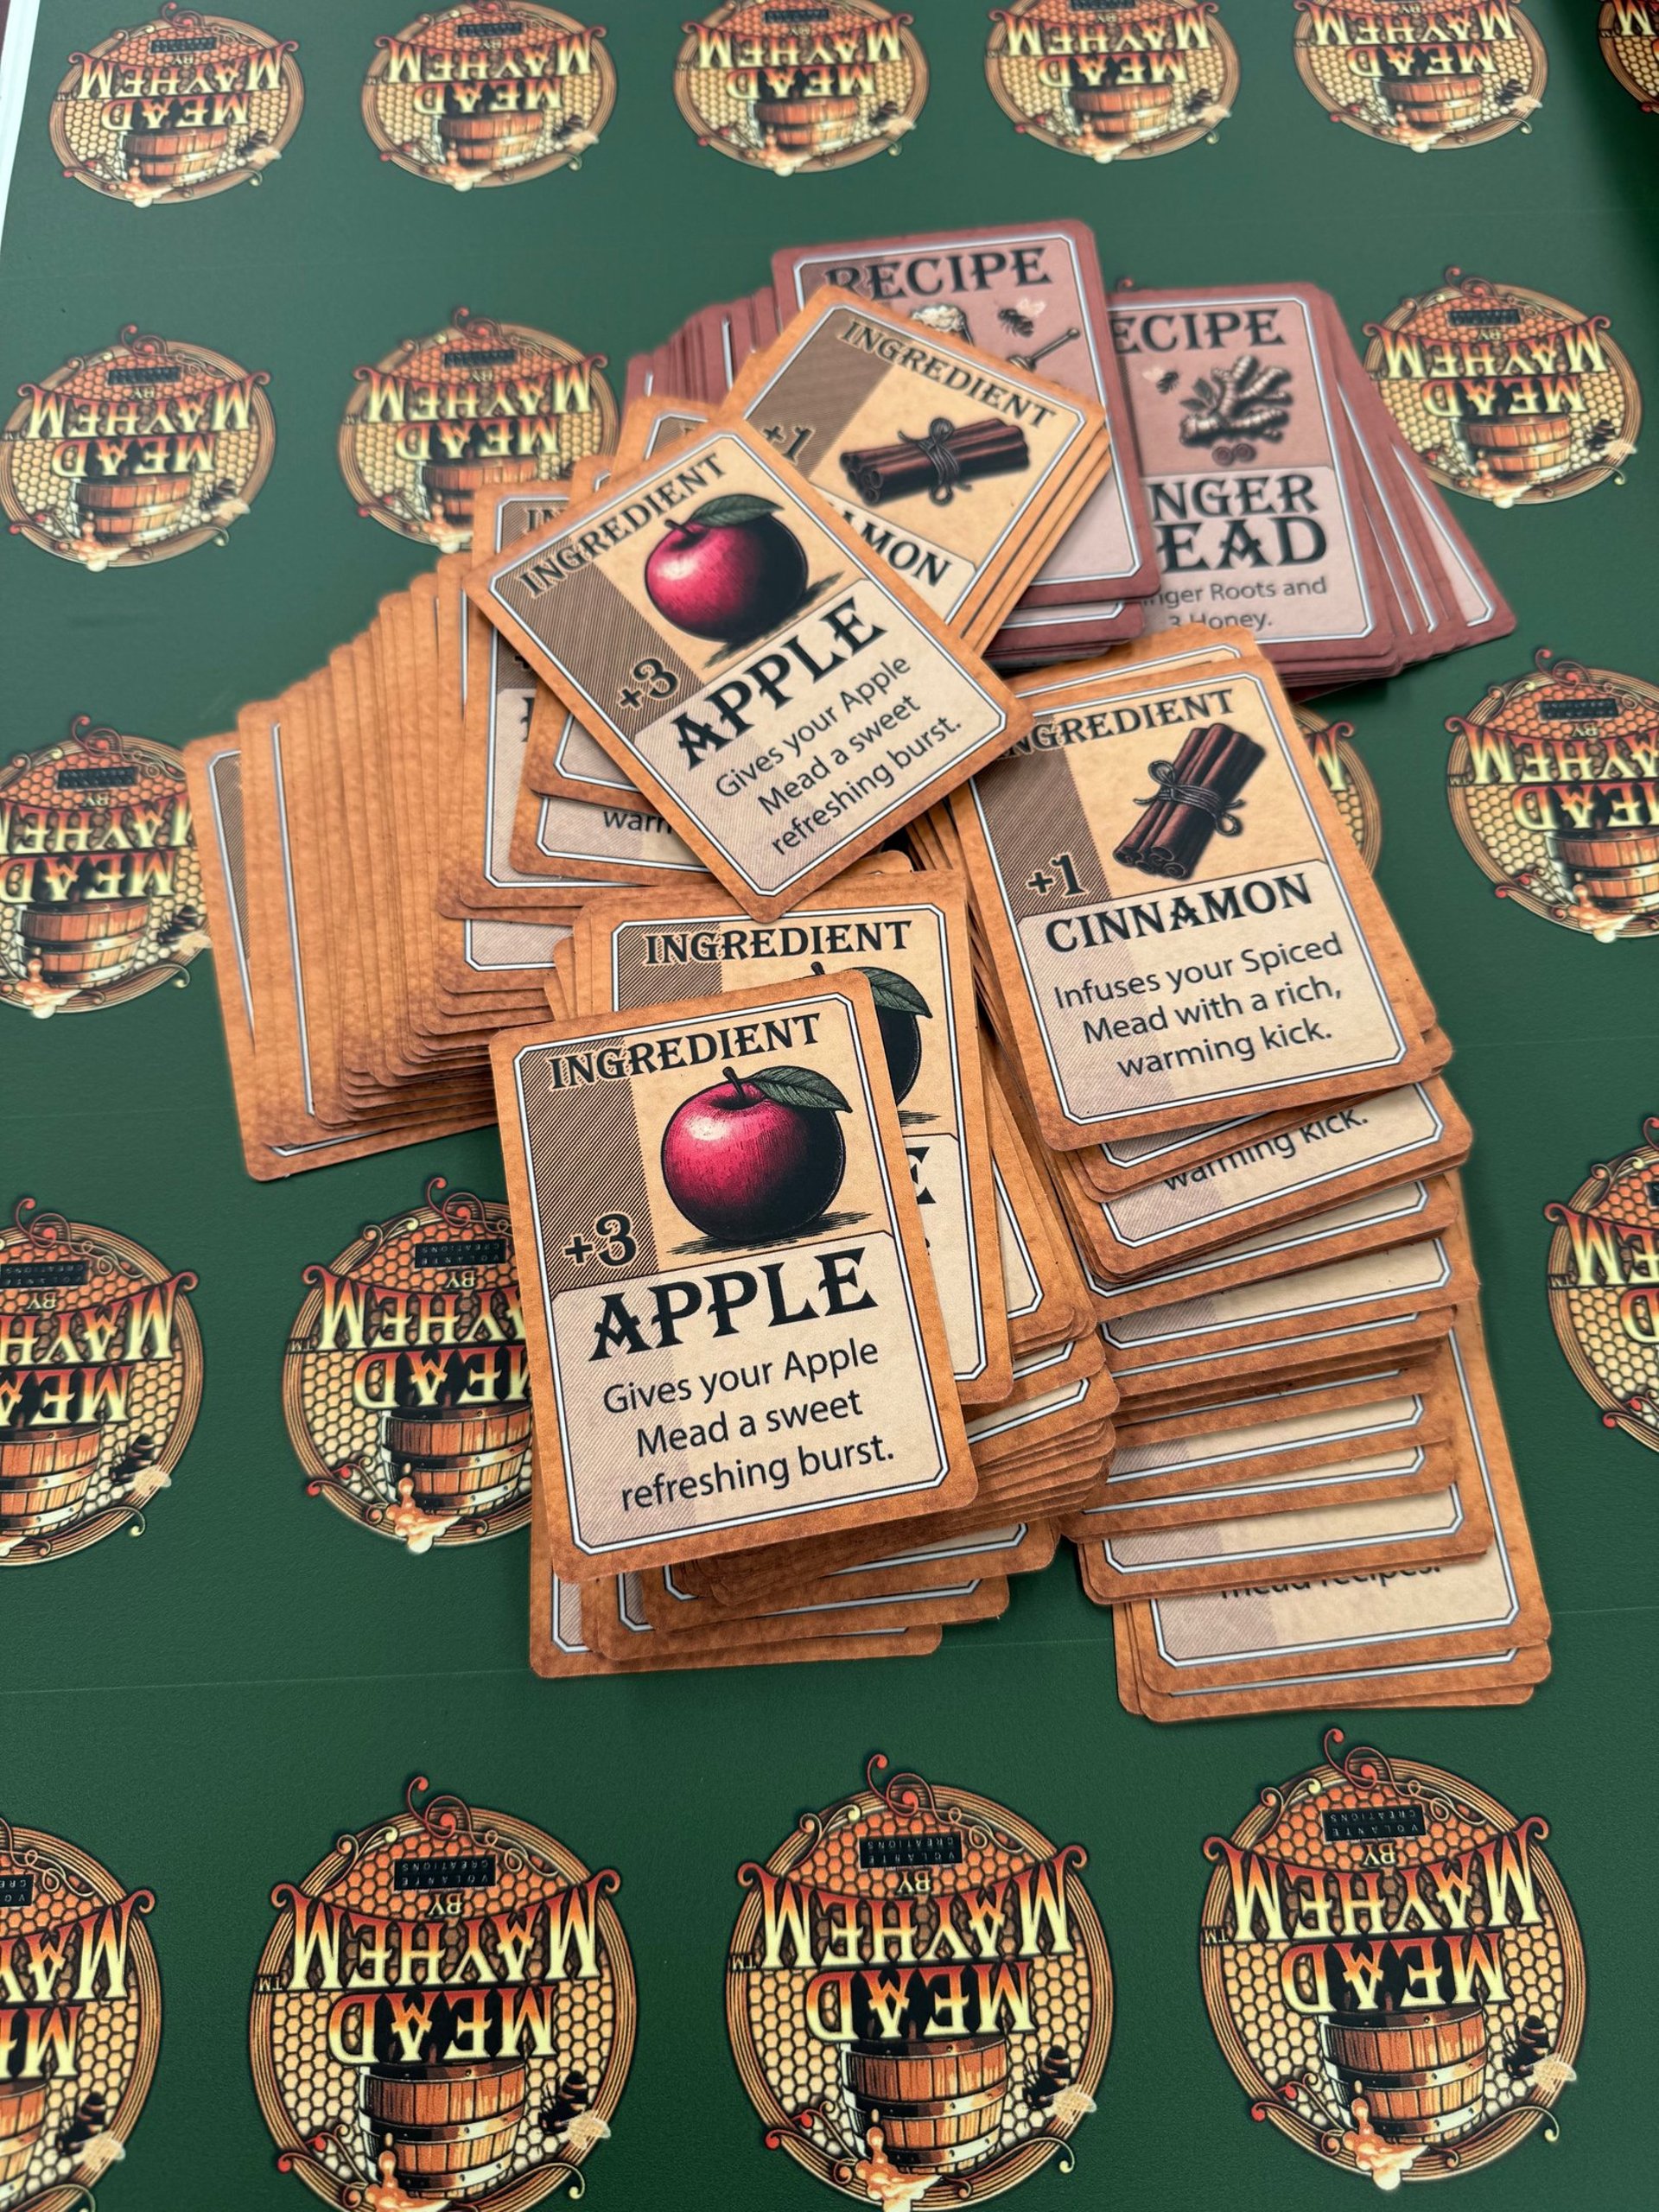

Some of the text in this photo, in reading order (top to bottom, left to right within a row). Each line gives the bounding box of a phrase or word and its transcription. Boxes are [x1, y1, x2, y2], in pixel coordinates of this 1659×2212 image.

[682, 15, 913, 68] MAYHEM
[988, 3, 1218, 56] MAYHEM
[1294, 0, 1521, 45] MAYHEM
[68, 41, 299, 99] MAYHEM
[375, 27, 606, 83] MAYHEM
[1039, 52, 1188, 87] MEAD
[1347, 41, 1497, 77] MEAD
[414, 79, 562, 115] MEAD
[727, 65, 874, 99] MEAD
[101, 92, 249, 130] MEAD
[826, 247, 1051, 301] RECIPE
[1109, 309, 1285, 354] ECIPE
[1363, 316, 1611, 378] MAYHEM
[354, 354, 607, 423] MAYHEM
[839, 321, 1056, 426] INGREDIENT
[1421, 375, 1588, 417] MEAD
[17, 372, 270, 439] MAYHEM
[52, 435, 215, 477] MEAD
[395, 417, 559, 461] MEAD
[763, 426, 814, 464] +1
[1149, 474, 1318, 520] NGER
[518, 454, 727, 598] INGREDIENT
[1156, 516, 1328, 574] EAD
[1211, 580, 1275, 601] Roots
[1284, 576, 1327, 596] and
[617, 658, 679, 711] +3
[670, 598, 887, 769] APPLE
[715, 654, 911, 798] Gives your Apple
[1445, 716, 1659, 784] AYHEM
[1571, 722, 1599, 737] BY
[757, 694, 922, 817] Mead a sweet
[772, 718, 962, 856] refreshing burst.
[1512, 782, 1659, 830] EAD
[0, 792, 192, 854] AYHE
[0, 850, 175, 902] MEAD
[1026, 854, 1086, 899] +1
[1045, 873, 1313, 953] CINNAMON
[645, 919, 912, 966] INGREDIENT
[1054, 932, 1344, 1009] Infuses your Spiced
[1082, 975, 1342, 1044] Mead with a rich,
[546, 1013, 821, 1091] INGREDIENT
[1116, 1017, 1332, 1077] warming kick.
[564, 1211, 639, 1268] +3
[27, 1290, 56, 1310] BY
[446, 1270, 476, 1288] BY
[588, 1245, 879, 1363] APPLE
[0, 1271, 198, 1366] MAYH
[289, 1339, 313, 1351] TM
[353, 1346, 531, 1408] EAD
[604, 1339, 880, 1418] Gives your Apple
[635, 1390, 864, 1460] Mead a sweet
[620, 1433, 895, 1512] refreshing burst.
[1330, 1809, 1416, 1823] CREATIONS
[1332, 1824, 1420, 1837] VOLANTE
[402, 1860, 489, 1872] CREATIONS
[868, 1837, 954, 1849] CREATIONS
[868, 1852, 956, 1865] VOLANTE
[1363, 1841, 1398, 1865] BY
[402, 1874, 489, 1887] VOLANTE
[429, 1893, 463, 1916] BY
[897, 1872, 931, 1893] BY
[1204, 1817, 1548, 1943] MAYHEM TM
[259, 1869, 620, 1992] MAYHEM TM
[729, 1846, 1087, 1971] MAYHEM TM
[1281, 1931, 1512, 2013] MEAD
[327, 1985, 557, 2065] MEAD
[806, 1961, 1035, 2042] MEAD
